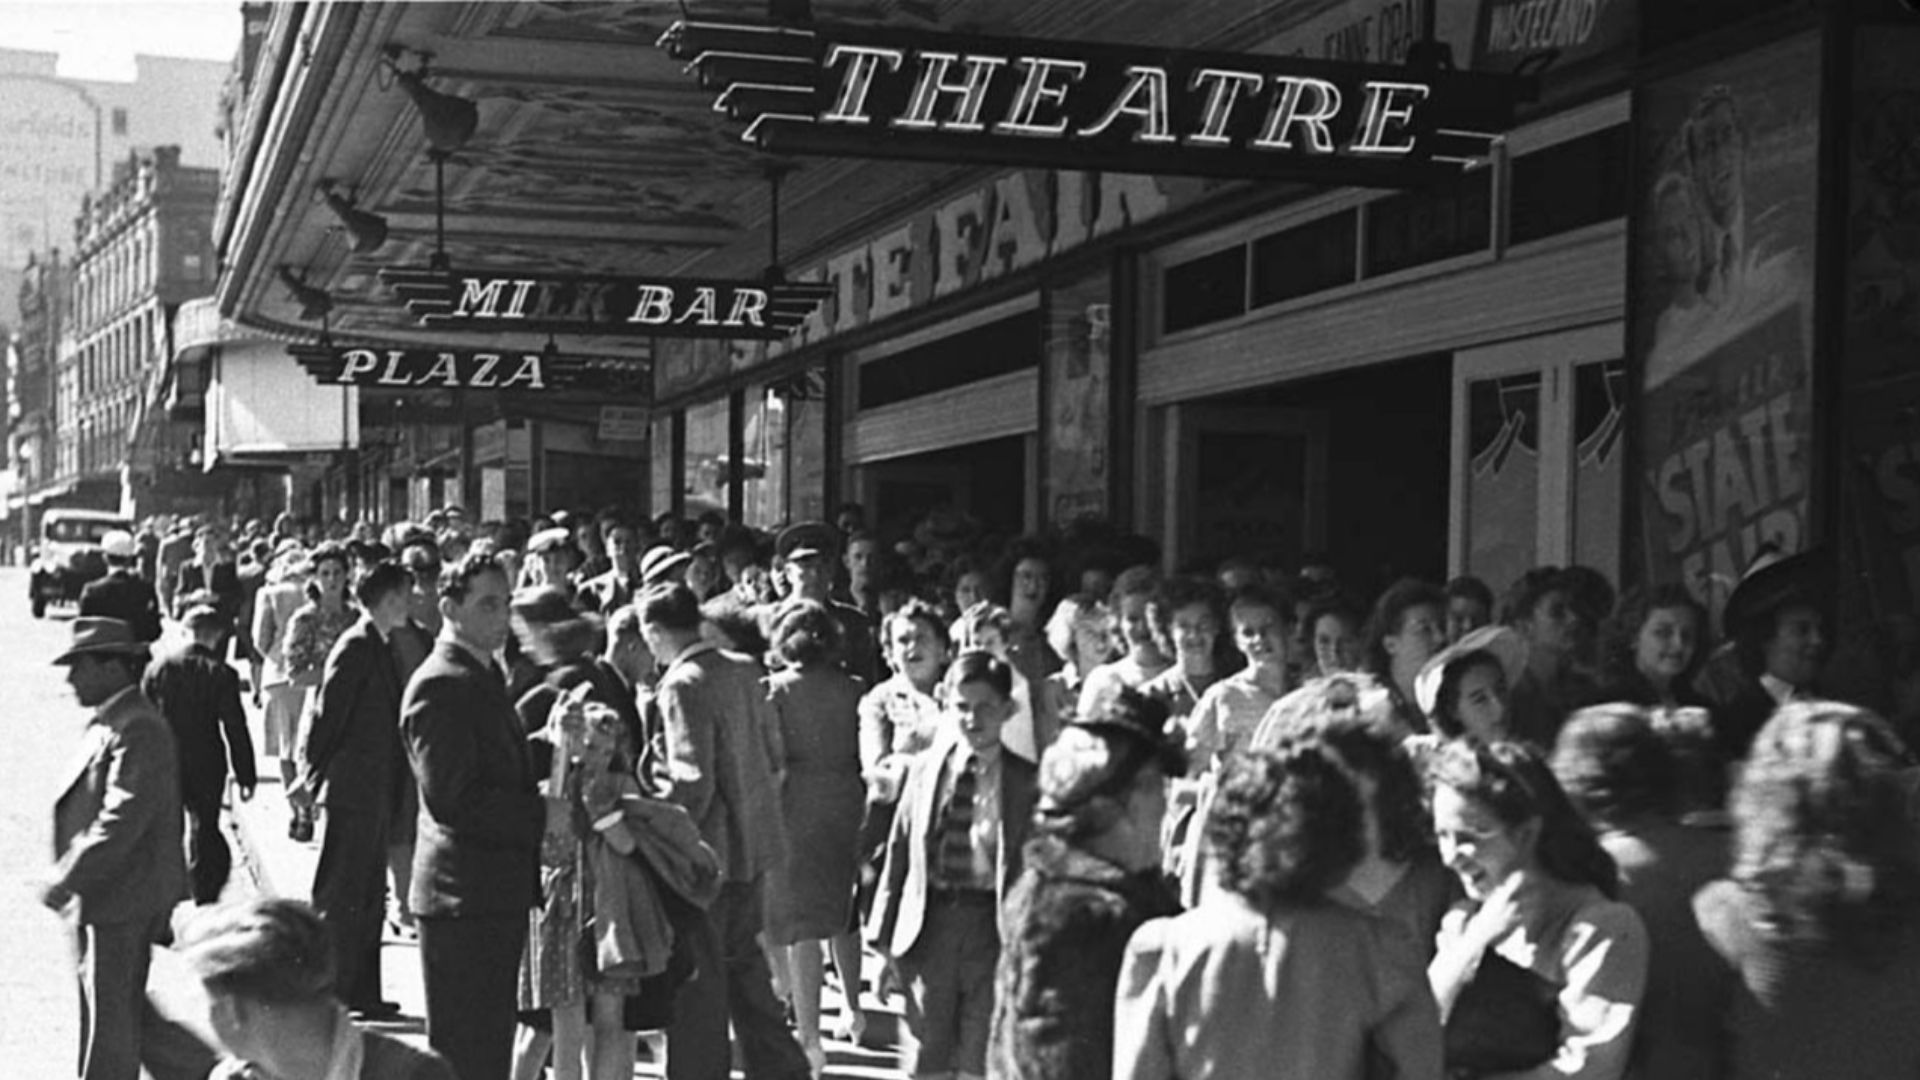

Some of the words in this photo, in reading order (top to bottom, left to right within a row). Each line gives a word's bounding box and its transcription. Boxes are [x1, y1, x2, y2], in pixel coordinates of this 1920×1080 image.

[823, 45, 1429, 154] THEATRE
[453, 277, 612, 321] MILK
[628, 284, 769, 327] BAR
[730, 220, 911, 371] ATE
[337, 349, 545, 388] PLAZA
[1657, 391, 1802, 553] STATE
